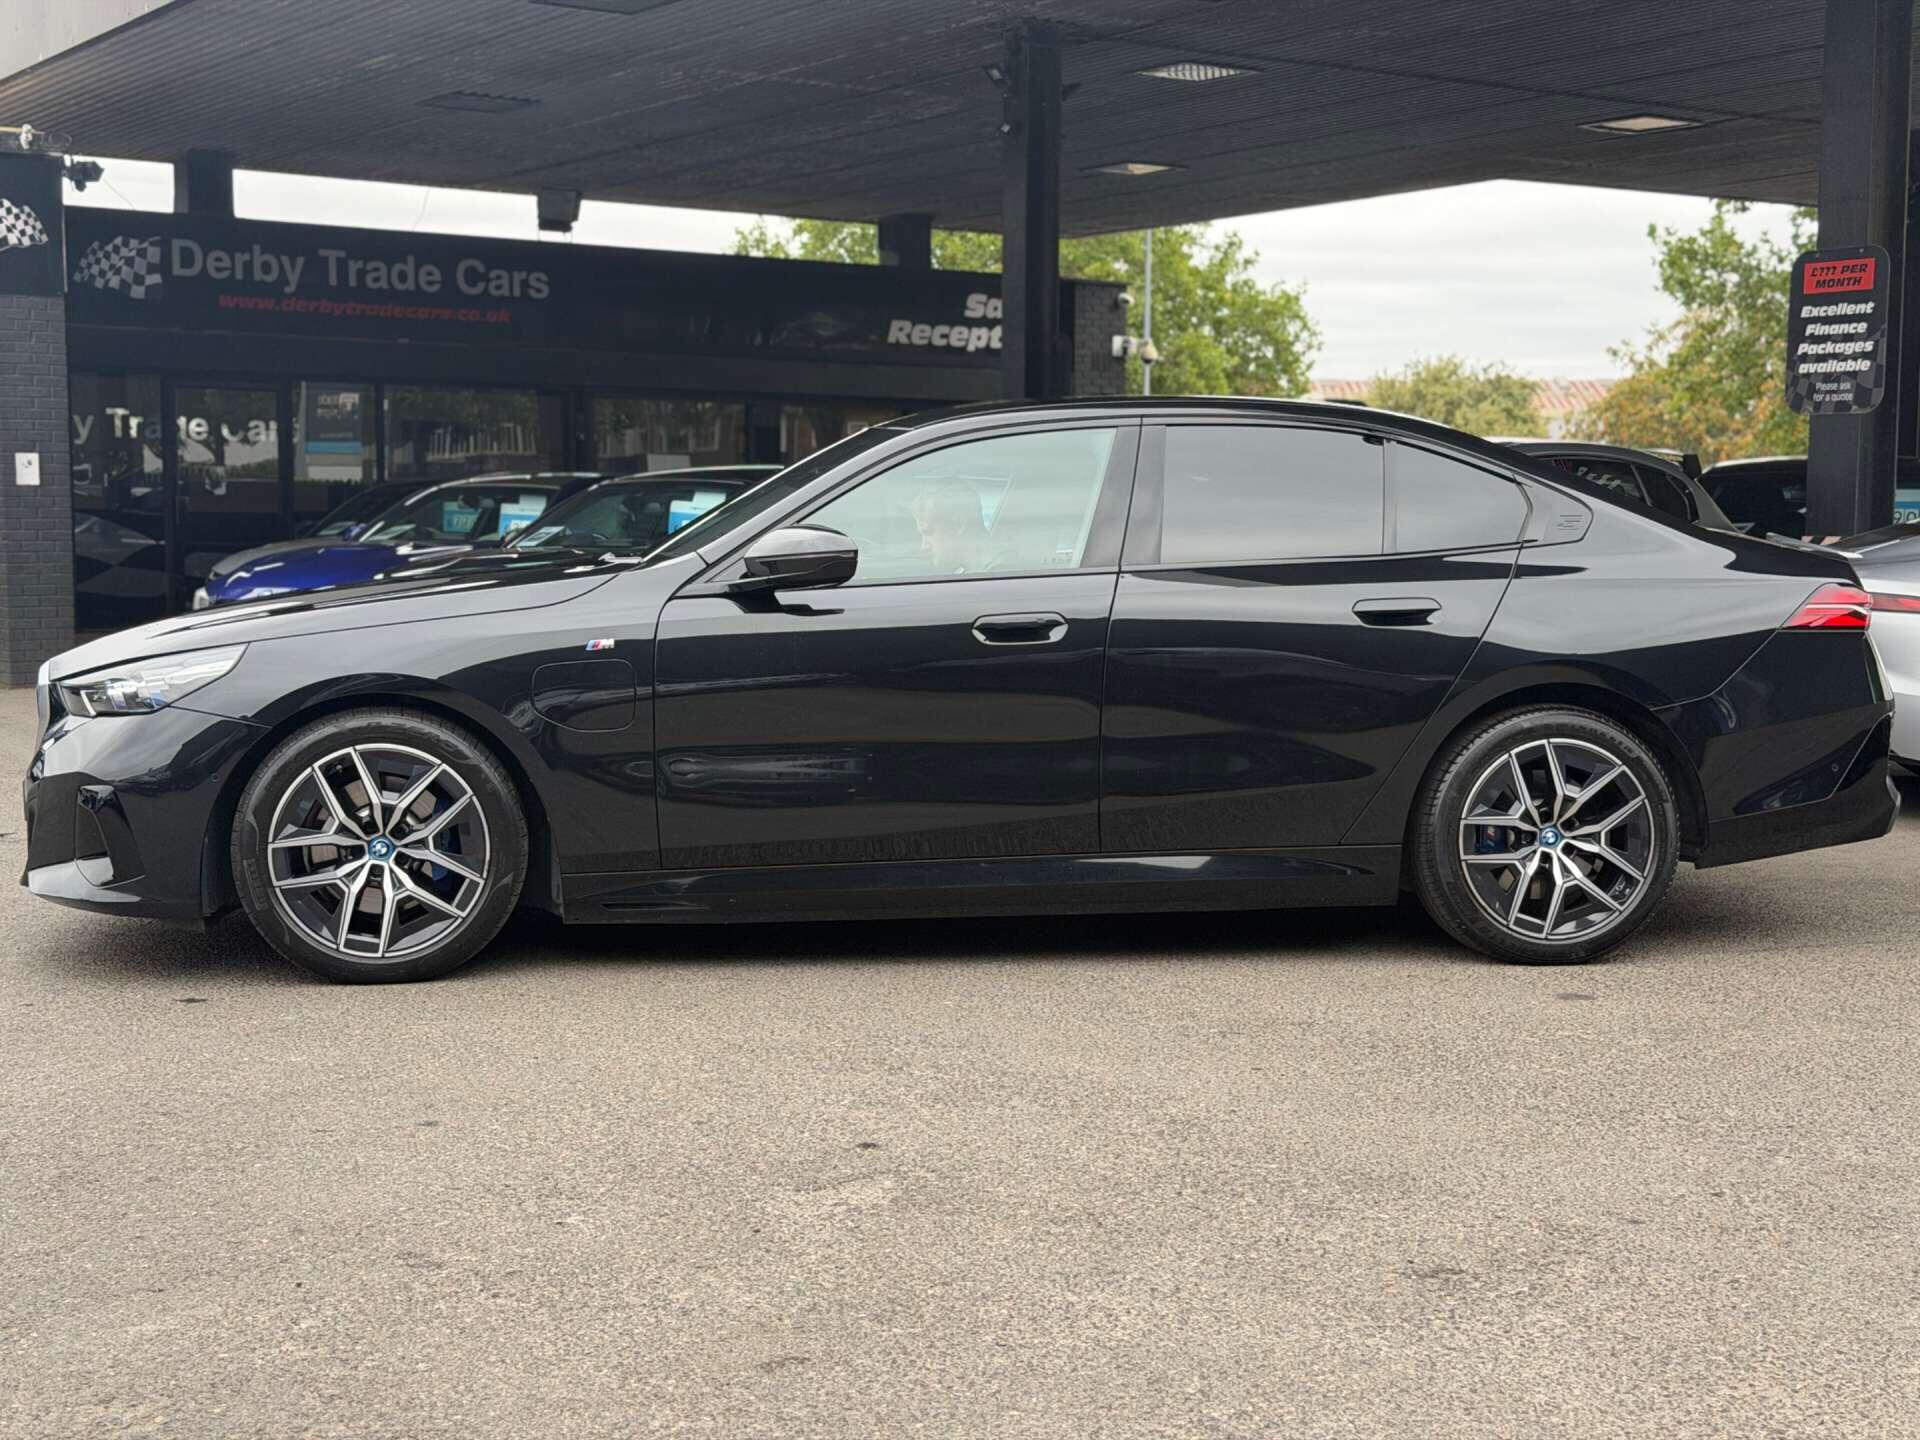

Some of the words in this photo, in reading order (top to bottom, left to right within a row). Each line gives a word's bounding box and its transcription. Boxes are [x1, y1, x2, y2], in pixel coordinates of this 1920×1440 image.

[171, 238, 305, 293] Derby
[318, 249, 442, 293] Trade
[455, 258, 550, 299] Cars
[1840, 263, 1868, 274] PER
[1815, 276, 1862, 289] MONTH
[218, 294, 513, 323] www.derbytradecars.co.uk
[1800, 301, 1875, 318] Excellent
[1805, 322, 1868, 336] Finance
[1797, 340, 1874, 355] Packages
[1798, 358, 1871, 374] available
[1815, 382, 1838, 391] Please
[1813, 393, 1824, 402] for
[1831, 392, 1854, 403] quote
